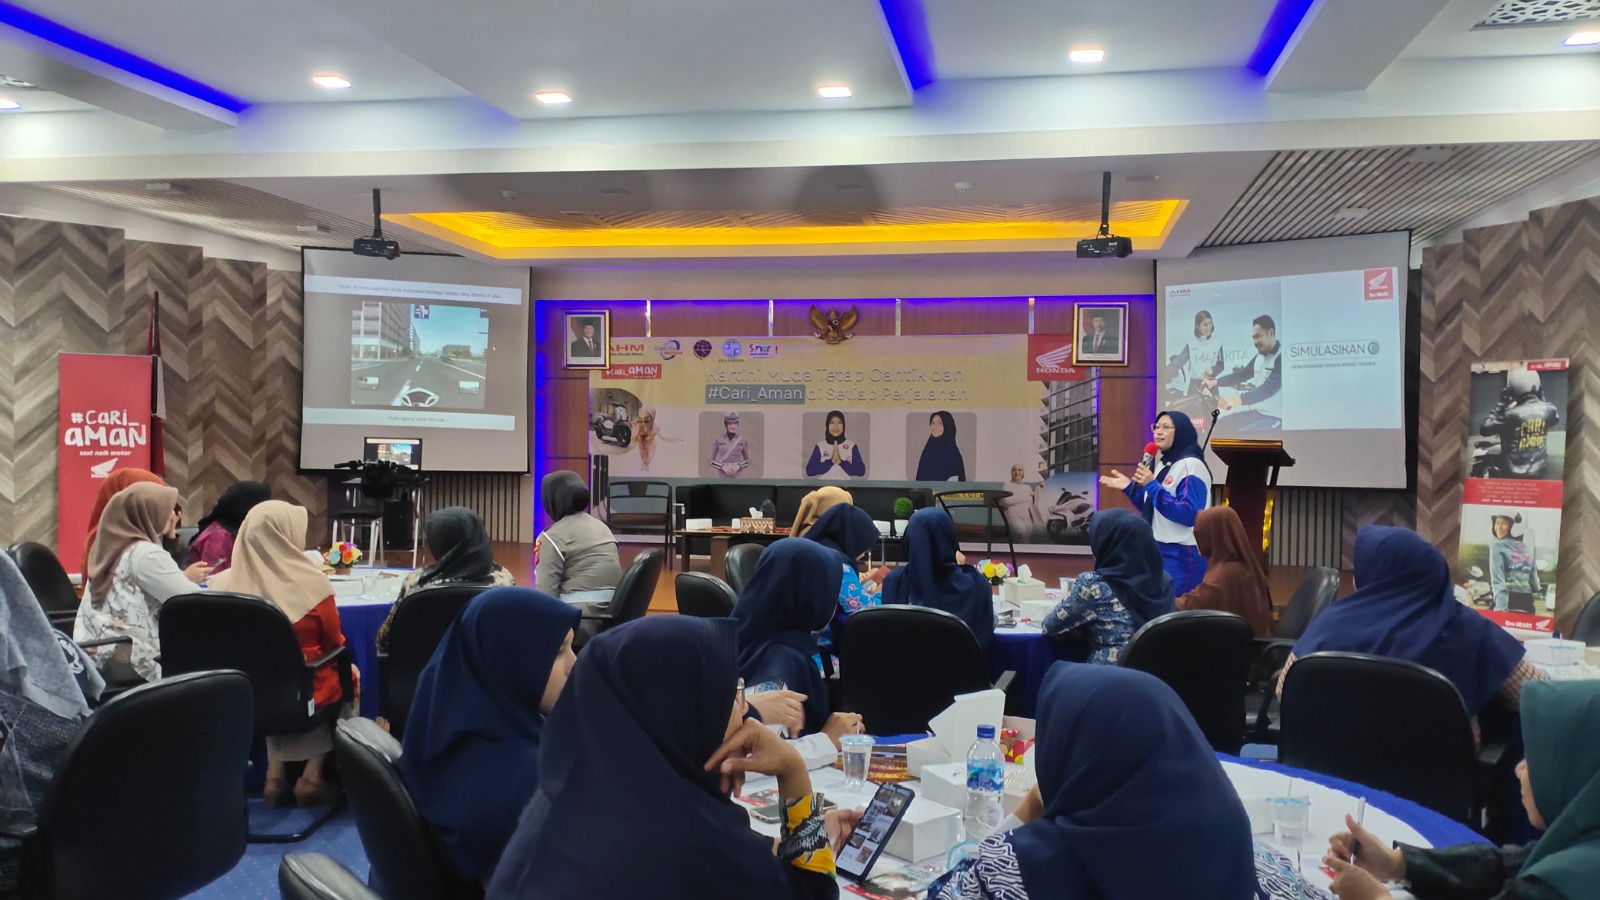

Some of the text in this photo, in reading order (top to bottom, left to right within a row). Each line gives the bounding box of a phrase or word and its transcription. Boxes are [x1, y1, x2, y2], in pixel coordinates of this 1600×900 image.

[1290, 343, 1366, 358] SIMULASIKAN
[816, 368, 865, 385] Tetap
[869, 368, 926, 382] Cantik
[930, 368, 965, 382] dan
[707, 386, 968, 404] #Cari_Aman di Setiap Perjalanan
